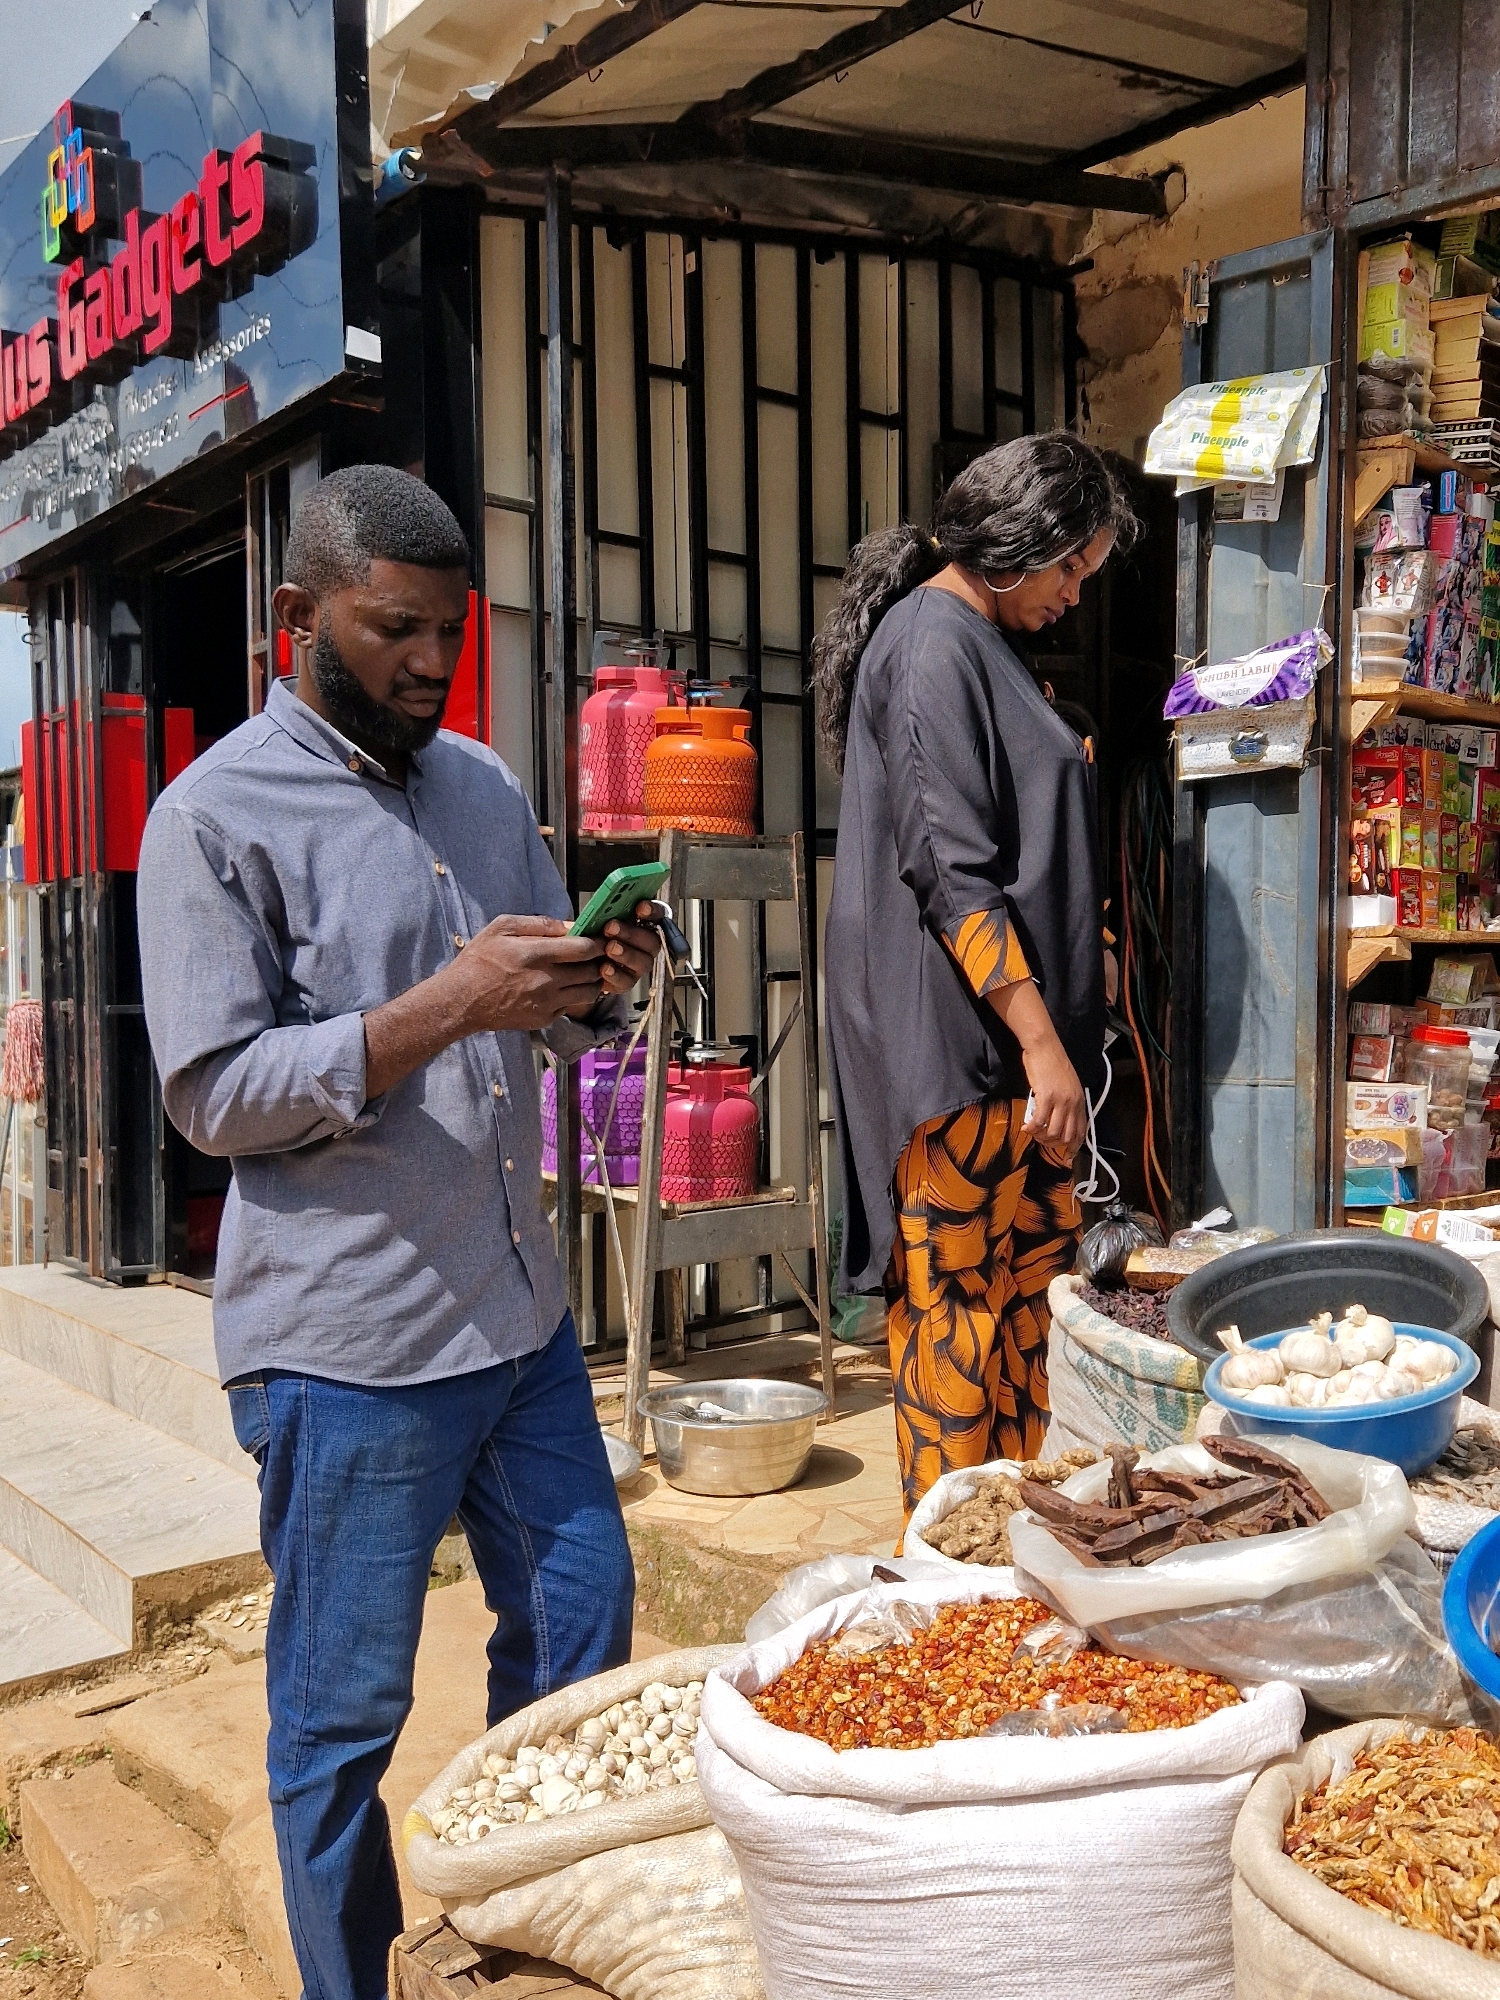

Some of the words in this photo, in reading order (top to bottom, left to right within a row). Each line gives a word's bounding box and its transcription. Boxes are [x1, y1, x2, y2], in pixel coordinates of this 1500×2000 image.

[58, 130, 265, 381] Gadgets
[193, 312, 271, 375] Accessories
[1208, 384, 1268, 397] Pineapple
[1190, 432, 1250, 450] Pineapple
[1202, 669, 1239, 684] SHUBH
[1241, 664, 1272, 679] LABH
[1216, 687, 1252, 699] LAVENDER
[1372, 812, 1395, 820] Fresh
